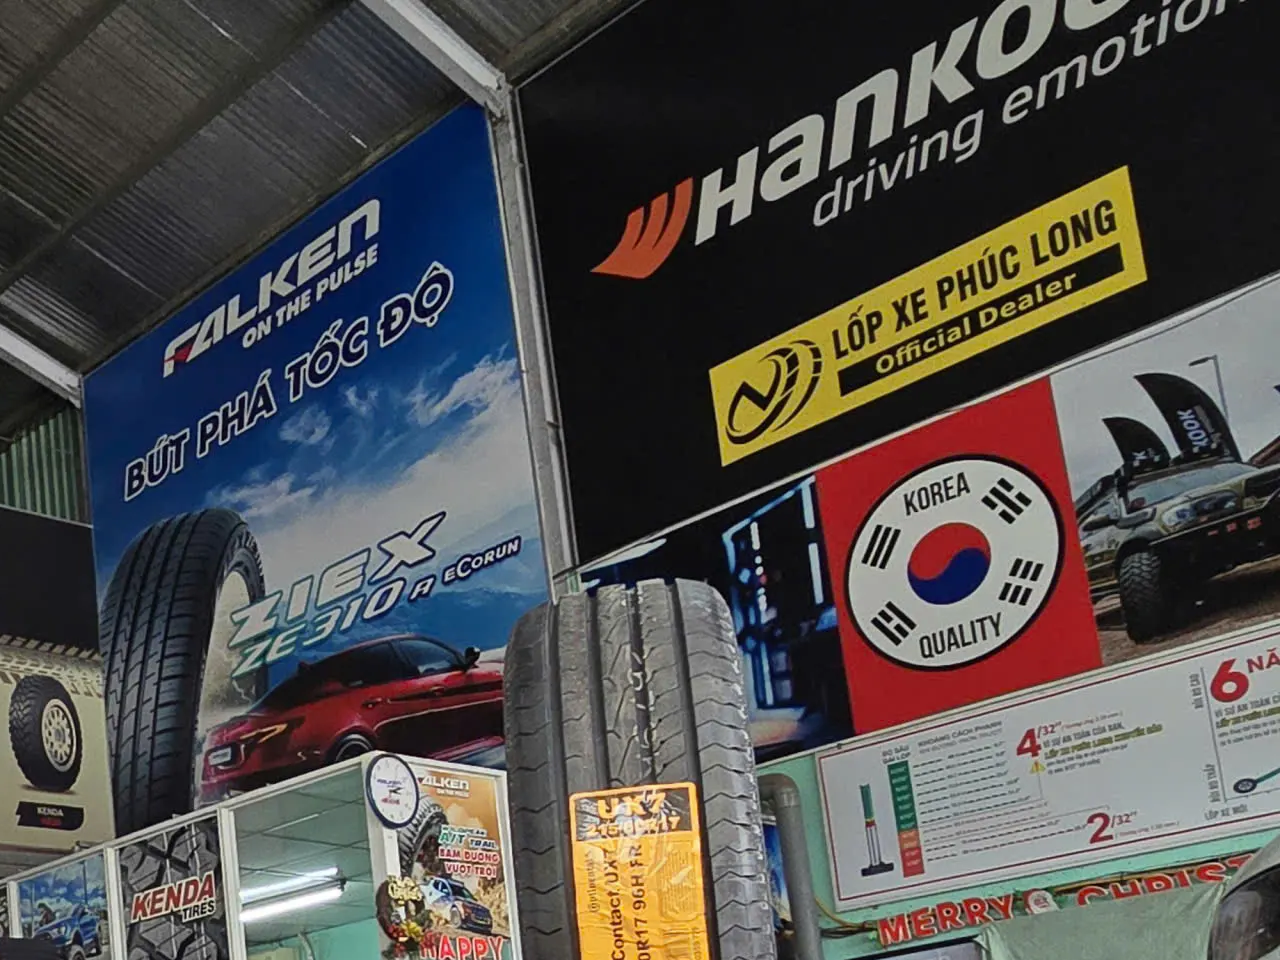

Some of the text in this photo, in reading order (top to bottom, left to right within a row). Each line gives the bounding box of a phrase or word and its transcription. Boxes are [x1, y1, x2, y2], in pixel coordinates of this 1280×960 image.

[813, 0, 1247, 227] driving emotio
[242, 243, 379, 348] ON THE PULSE
[832, 199, 1117, 359] LỐP XE PHÚC LONG
[876, 271, 1076, 374] Official Dealer
[196, 368, 277, 458] PHÁ
[285, 316, 368, 402] TỐC
[377, 261, 454, 348] ĐỘ
[902, 472, 970, 516] KOREA
[227, 511, 447, 648] ZIEX
[919, 612, 1003, 659] QUALITY
[1210, 658, 1249, 703] 6
[417, 776, 470, 790] ALKEN
[629, 844, 644, 867] FR
[131, 871, 216, 922] KENDA
[183, 900, 216, 921] TIRES
[630, 875, 647, 910] 96H
[878, 893, 1014, 946] MERRY
